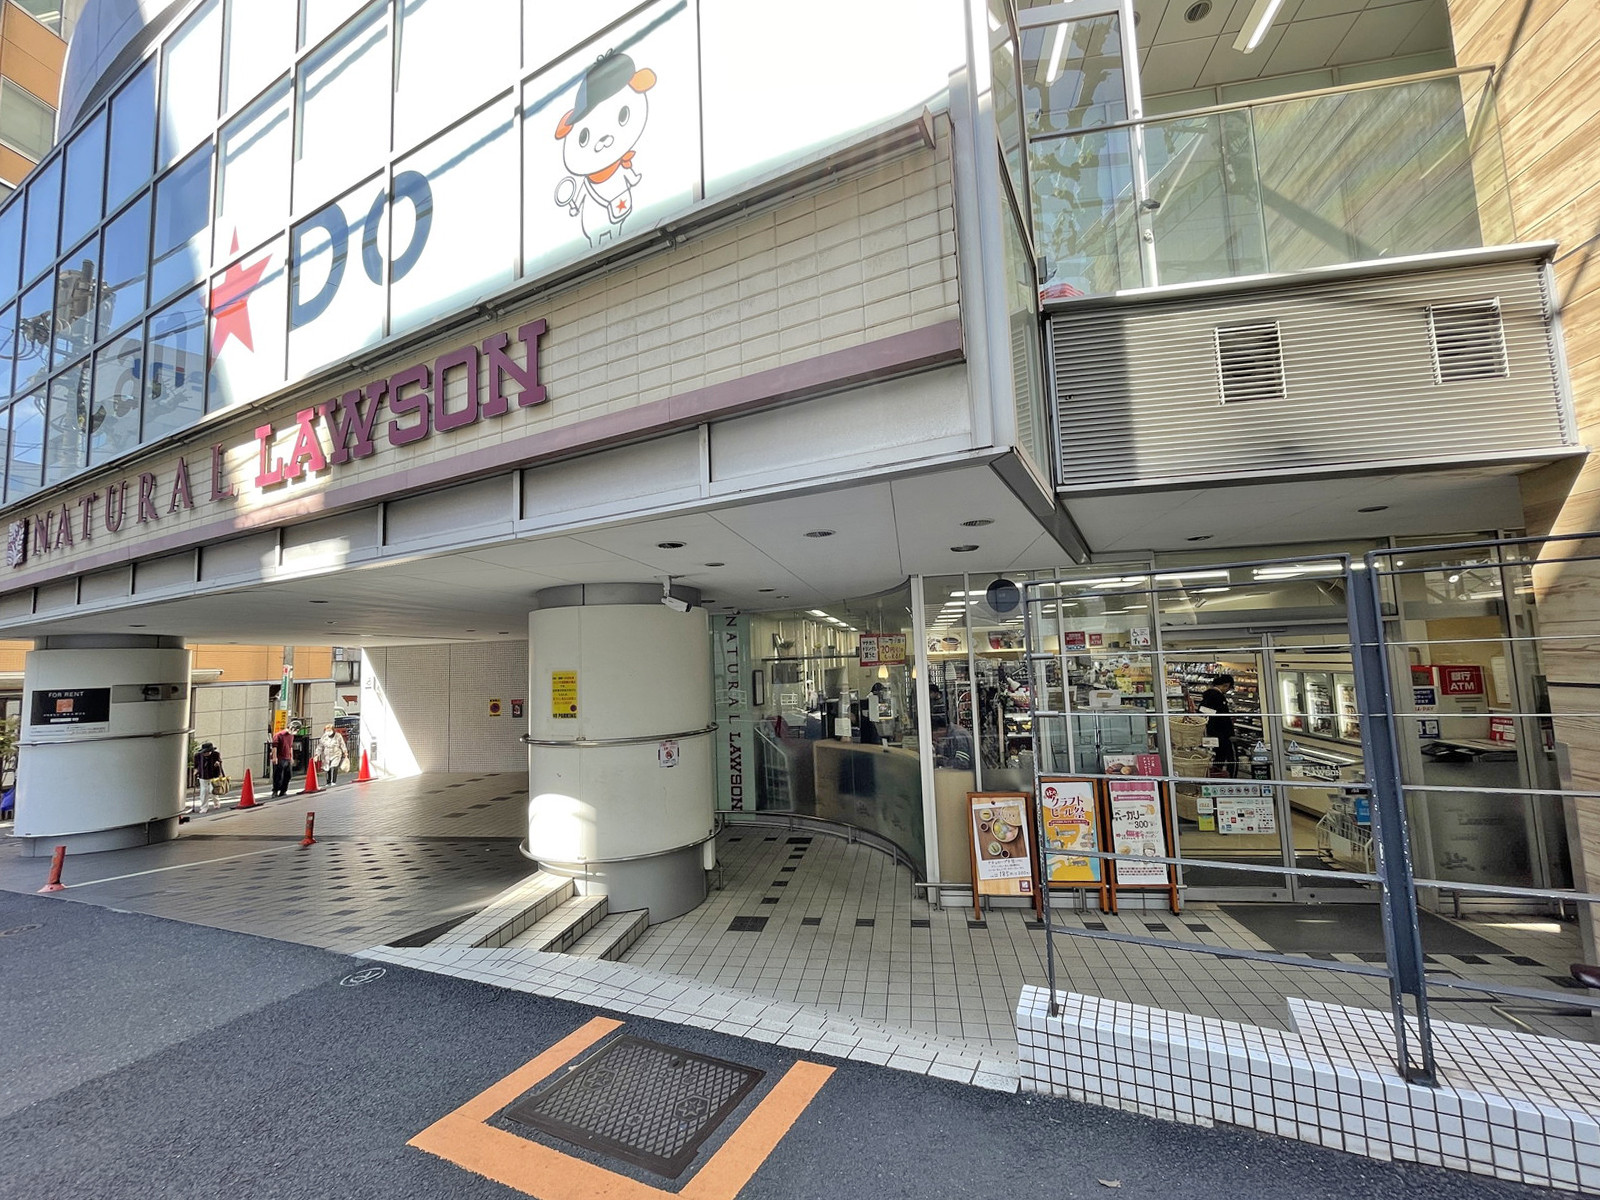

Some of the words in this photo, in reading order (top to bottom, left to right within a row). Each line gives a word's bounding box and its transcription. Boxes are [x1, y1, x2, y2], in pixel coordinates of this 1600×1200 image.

[32, 443, 239, 557] NATURAL
[254, 318, 548, 488] LAWSON
[726, 616, 742, 725] NATURAL
[1450, 671, 1471, 681] 銀行
[1450, 682, 1474, 691] ATM
[729, 732, 743, 811] LAWSON
[1051, 796, 1084, 808] クラフト
[1134, 820, 1149, 829] 300
